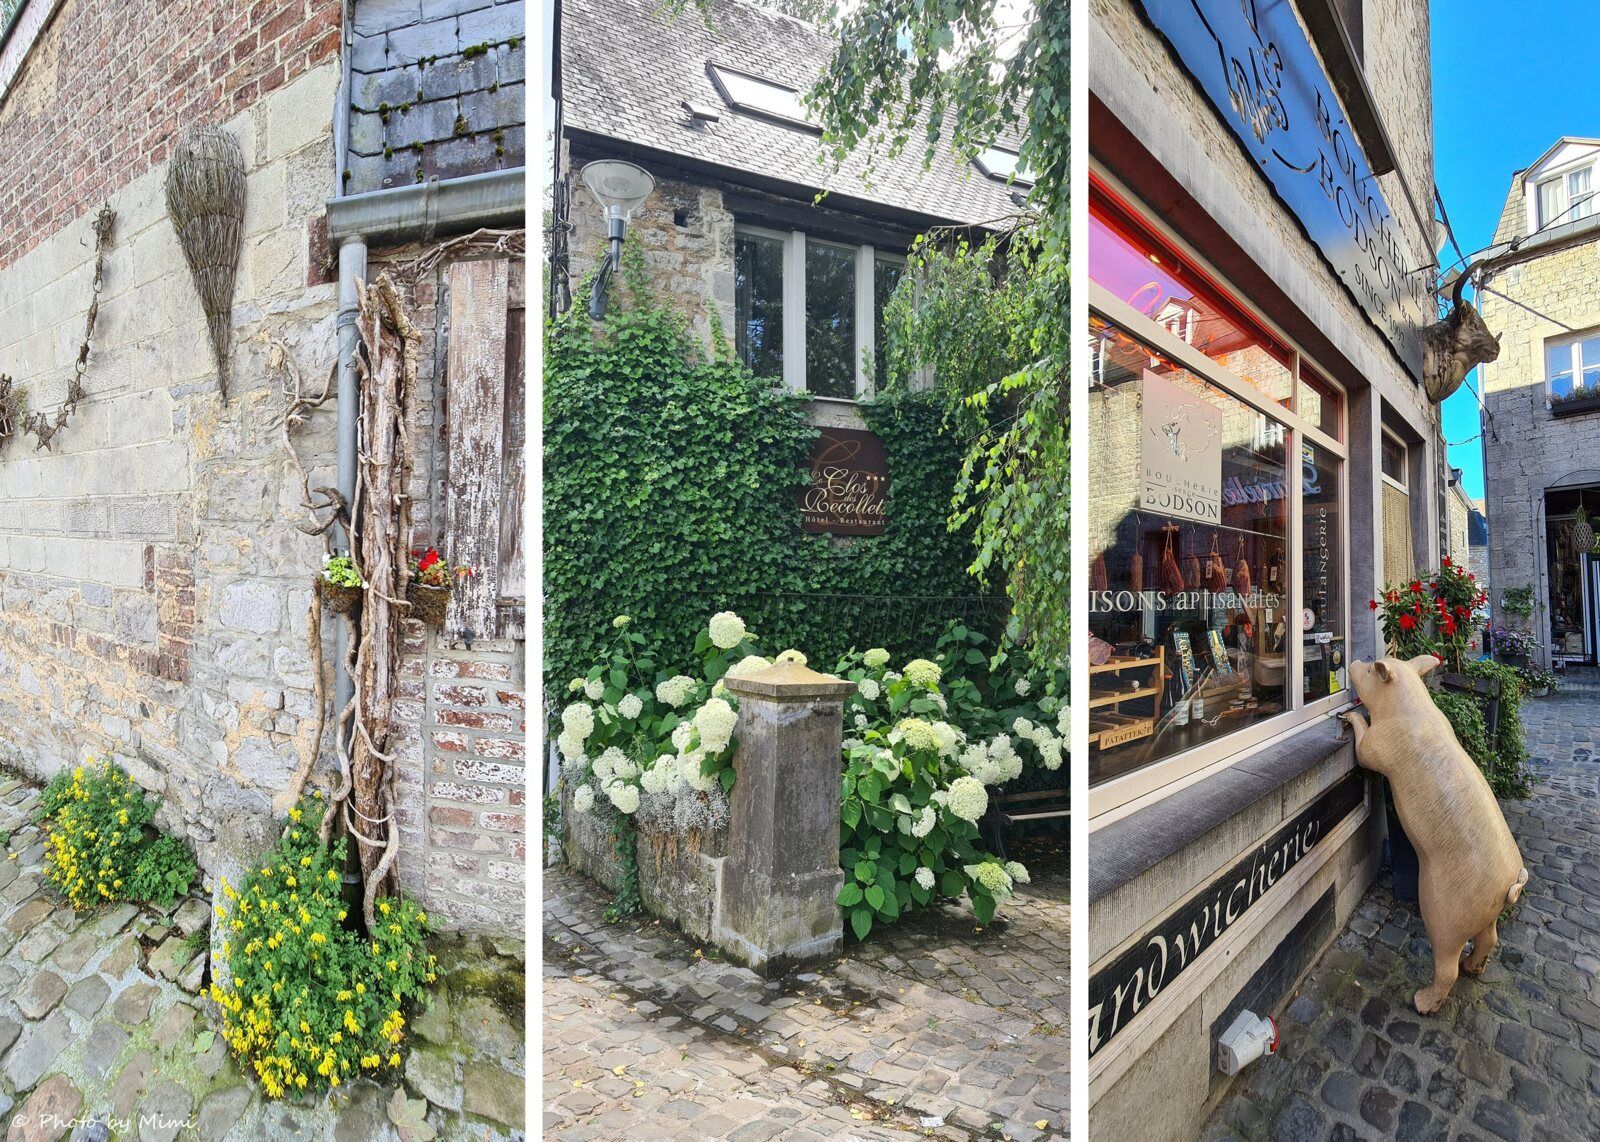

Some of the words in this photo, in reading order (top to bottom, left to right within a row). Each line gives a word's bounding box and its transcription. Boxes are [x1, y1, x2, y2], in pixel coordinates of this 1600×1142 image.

[1314, 84, 1421, 312] BOUCHERIE
[1317, 147, 1401, 311] BODSON
[1355, 263, 1387, 322] SINCE
[823, 466, 868, 496] Clos
[844, 491, 857, 502] des
[1145, 486, 1219, 519] BODSON
[840, 517, 886, 525] Restaurant
